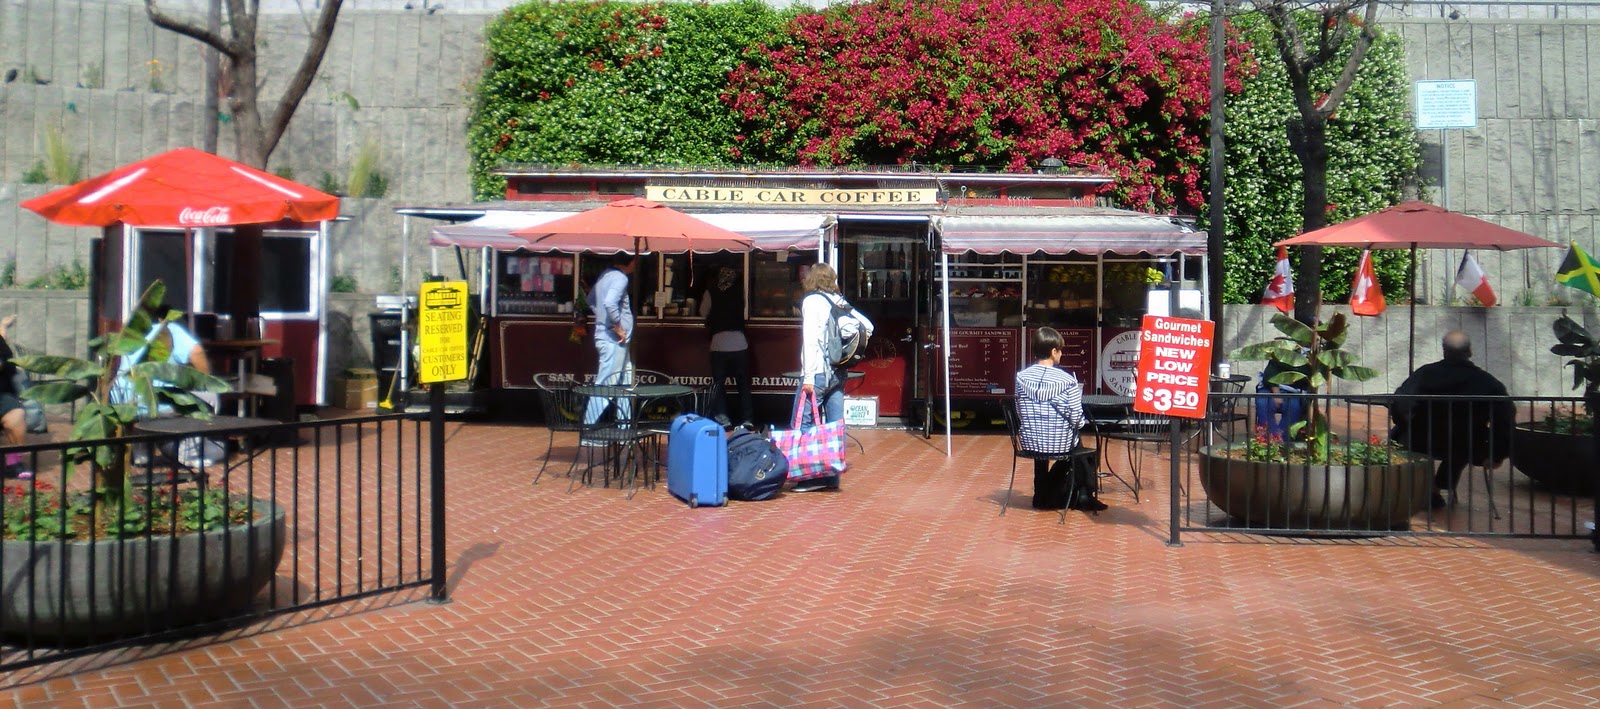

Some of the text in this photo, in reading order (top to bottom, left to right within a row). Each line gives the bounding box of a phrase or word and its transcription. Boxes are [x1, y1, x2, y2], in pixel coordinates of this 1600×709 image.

[662, 188, 921, 203] CABLE CAR COFFEE
[425, 311, 462, 322] SEATING
[424, 323, 463, 335] RESERVED
[1154, 318, 1202, 334] Gourmet
[1143, 330, 1210, 348] Sandwiches
[422, 353, 465, 364] CUSTOMERS
[1155, 346, 1196, 360] NEW
[431, 364, 457, 377] ONLY
[1154, 360, 1193, 373] LOW
[549, 373, 575, 383] SAN
[752, 376, 801, 386] RAILWA
[1146, 371, 1199, 387] PRICE
